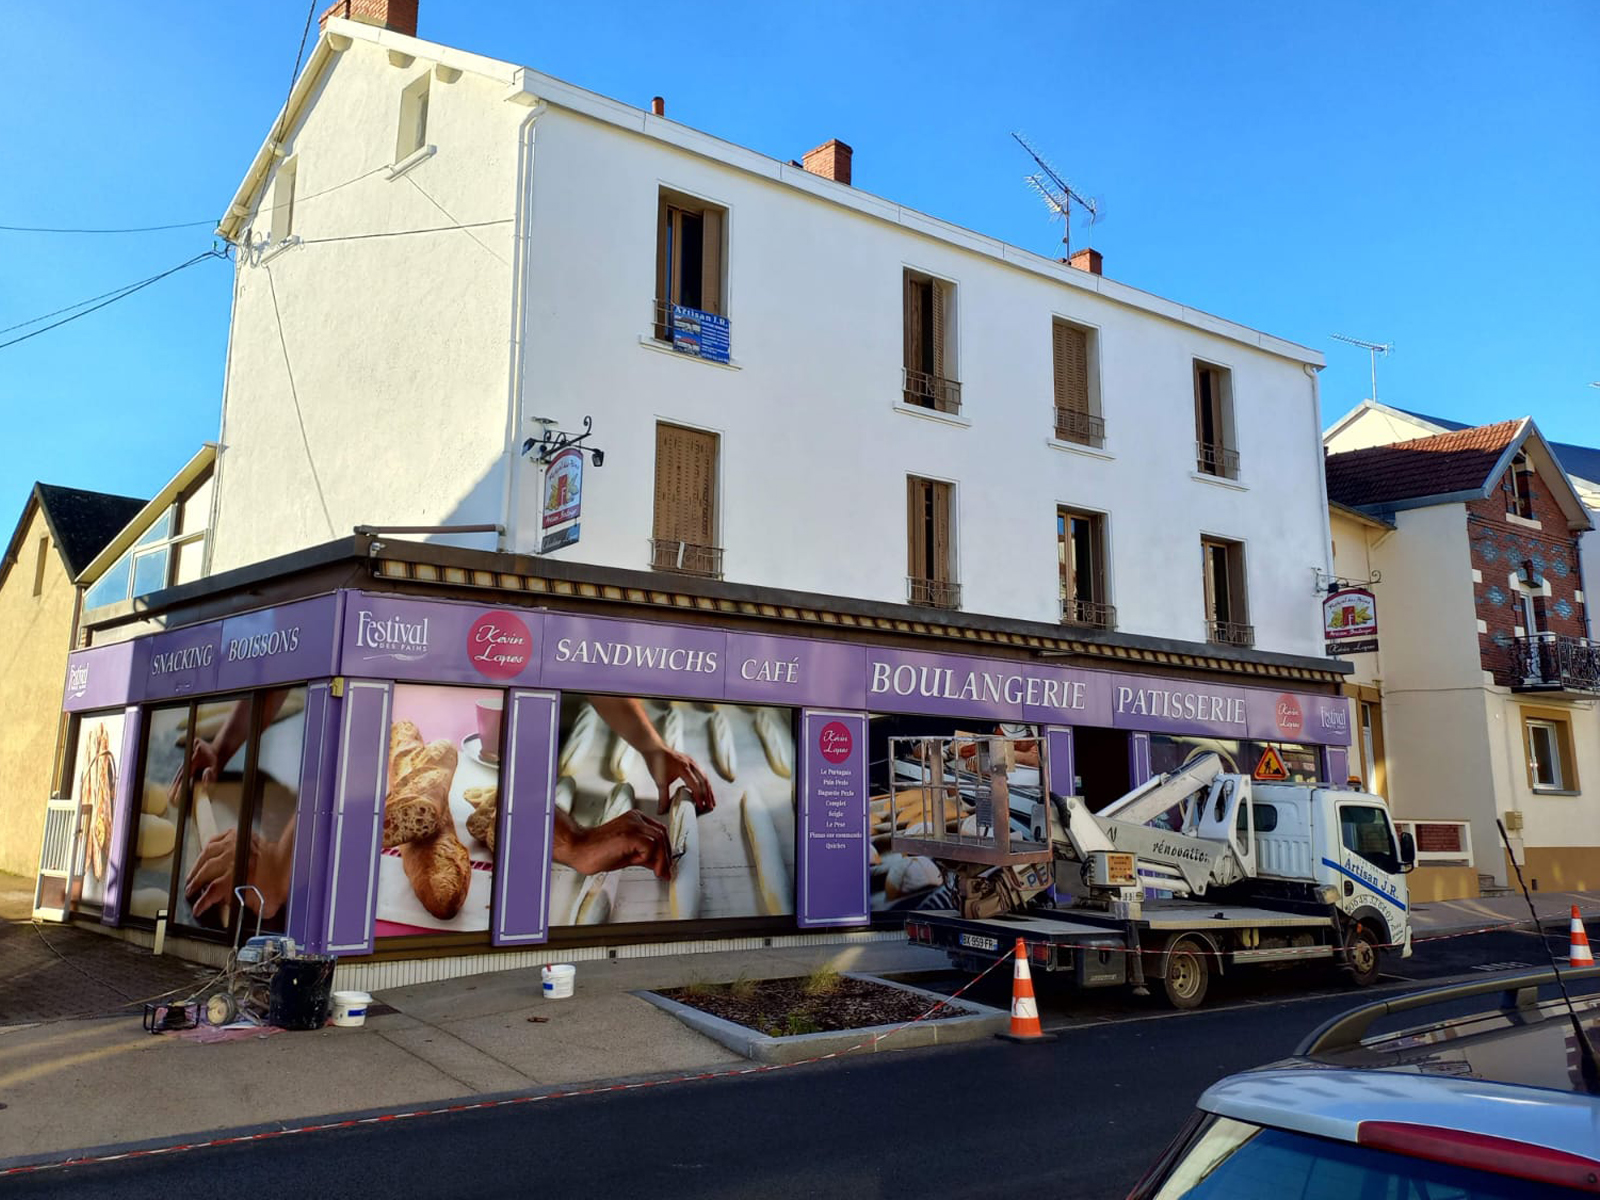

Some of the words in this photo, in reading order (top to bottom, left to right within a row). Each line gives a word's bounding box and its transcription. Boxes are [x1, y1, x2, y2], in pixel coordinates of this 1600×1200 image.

[228, 627, 300, 662] BOISSONS
[356, 610, 429, 648] Festival
[151, 645, 213, 675] SNACKING
[473, 644, 524, 666] Lopes
[555, 638, 718, 674] SANDWICHS
[740, 656, 799, 685] CAFÉ
[870, 661, 1087, 711] BOULANGERIE
[1116, 685, 1246, 724] PATISSERIE
[1344, 858, 1378, 887] Artisan
